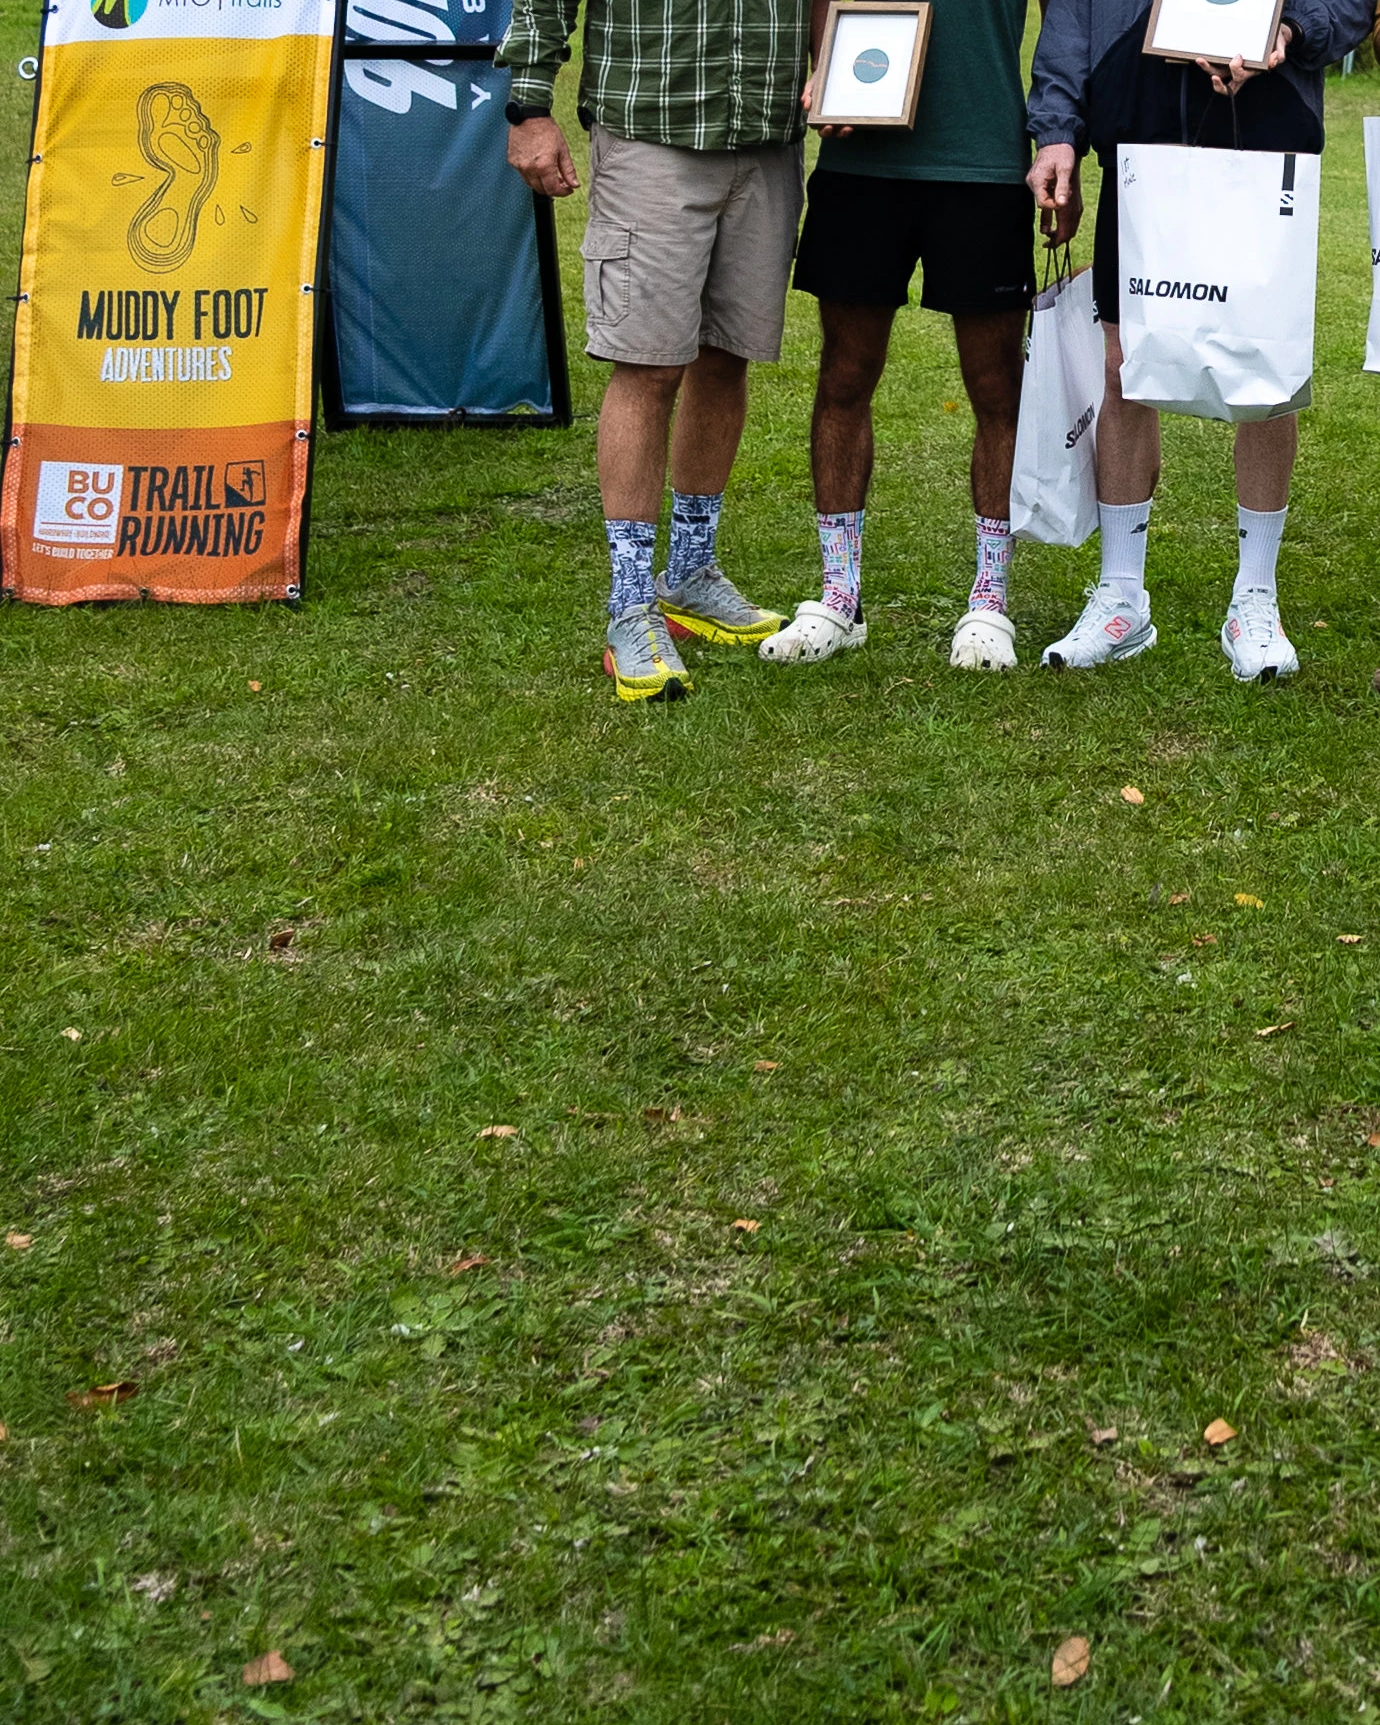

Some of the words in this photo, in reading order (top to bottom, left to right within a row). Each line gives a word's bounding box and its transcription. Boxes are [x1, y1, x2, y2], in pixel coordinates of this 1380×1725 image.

[1128, 277, 1228, 303] SALOMON
[77, 290, 181, 341] MUDDY
[194, 288, 268, 341] FOOT
[100, 346, 233, 383] ADVENTURES
[67, 470, 115, 493] BU
[128, 465, 220, 512] TRAIL
[65, 496, 114, 521] CO
[117, 510, 265, 557] RUNNING
